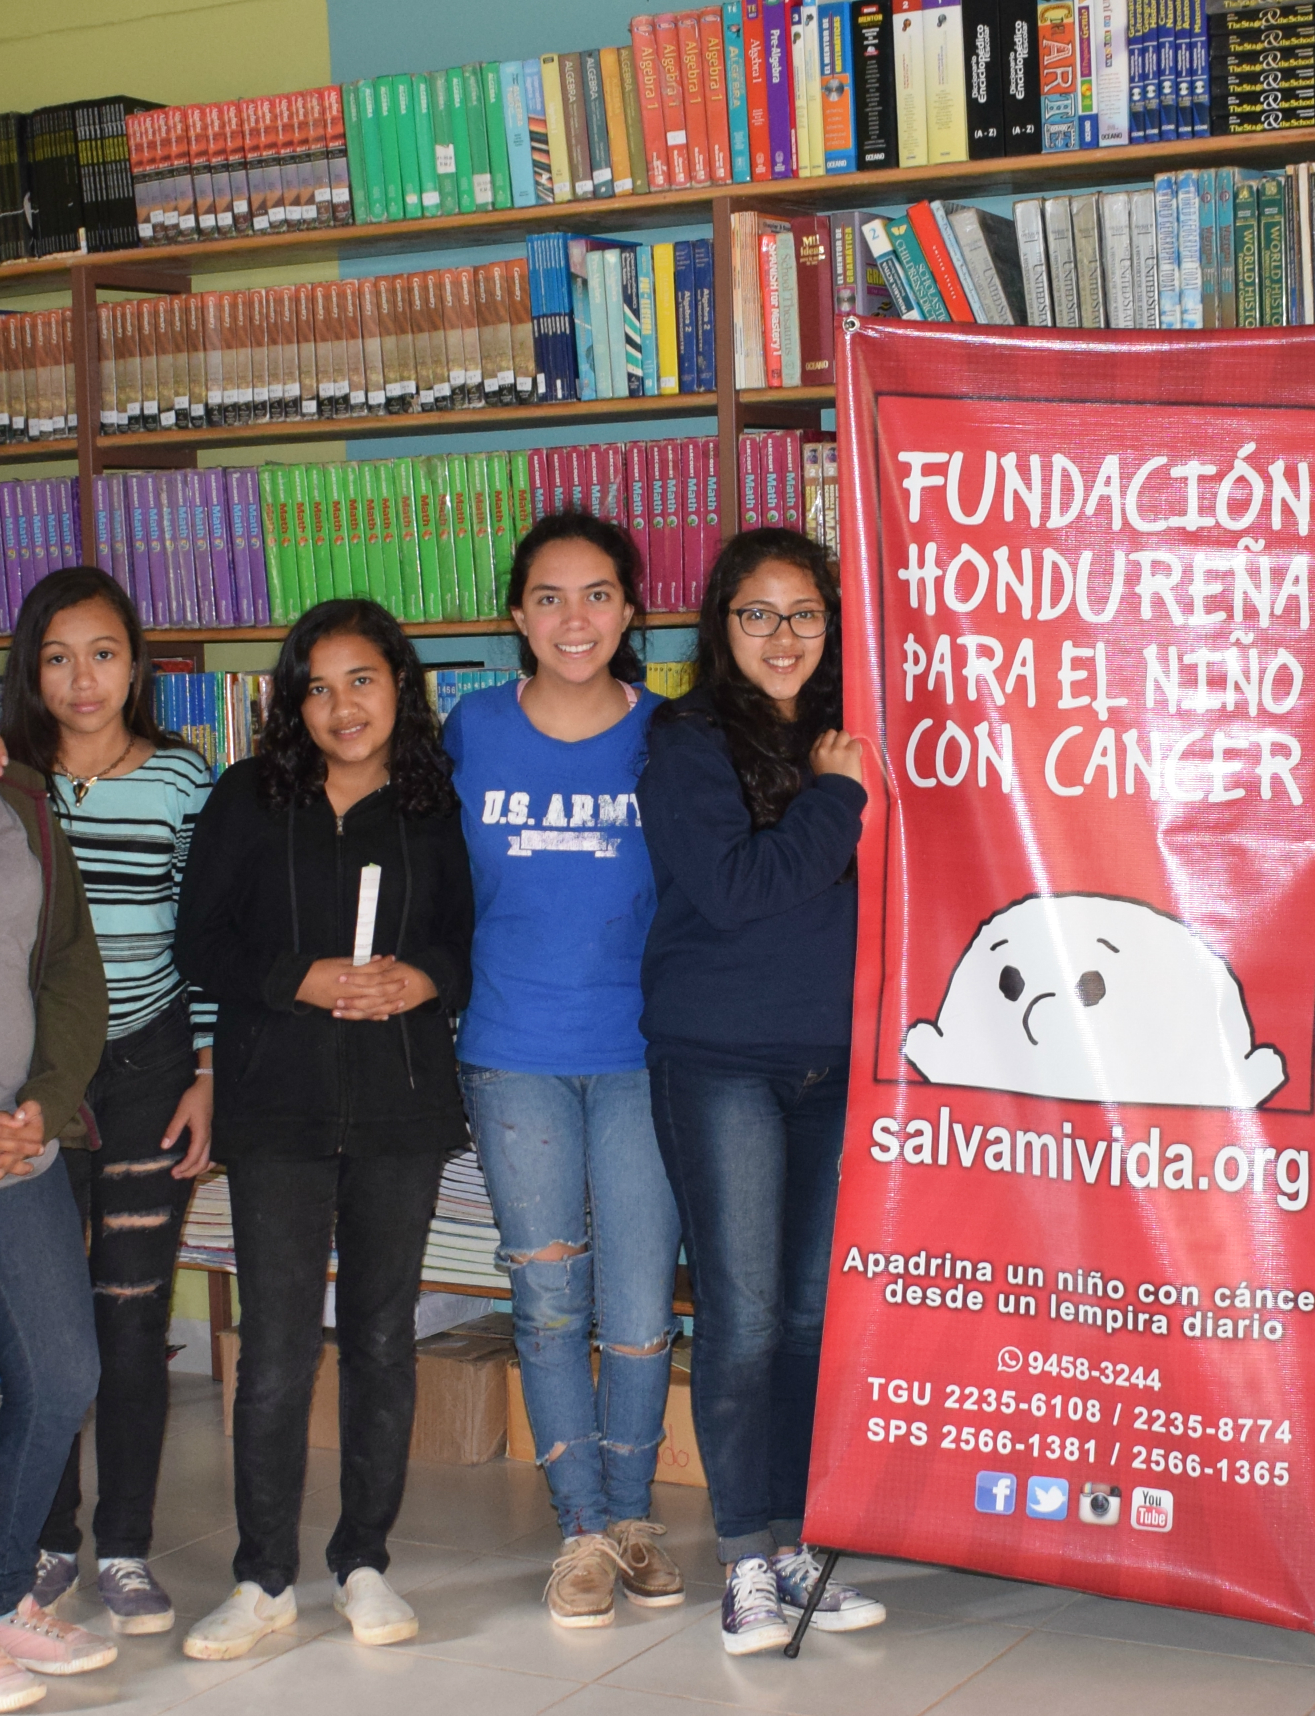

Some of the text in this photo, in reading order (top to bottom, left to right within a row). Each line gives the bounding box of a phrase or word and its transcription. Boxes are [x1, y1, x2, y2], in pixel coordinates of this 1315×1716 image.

[858, 14, 883, 23] MENTOR
[620, 49, 632, 93] ALGEBRA
[640, 47, 656, 99] Algebra
[662, 44, 677, 96] Algebra
[684, 41, 700, 93] Algebra
[706, 38, 722, 90] Algebra
[746, 38, 763, 77] Algebra
[769, 29, 782, 84] Pre-Algebra
[564, 60, 576, 104] ALGEBRA
[586, 56, 598, 101] ALGEBRA
[1101, 132, 1122, 141] OCEANO
[827, 160, 847, 169] OCEANO
[865, 153, 885, 161] OCEANO
[869, 228, 880, 240] 2
[769, 242, 779, 289] SPANISH
[1243, 229, 1255, 328] WORLD HISTO
[771, 308, 781, 349] Mastery
[806, 361, 828, 370] OCEANO
[707, 476, 717, 510] Math
[745, 474, 755, 508] Math
[766, 438, 777, 508] HARCOURT Math
[786, 472, 796, 506] Math
[898, 442, 1310, 536] FUNDACIÓN
[349, 499, 359, 530] Math
[366, 499, 376, 531] Math
[420, 495, 431, 527] Math
[494, 491, 504, 522] Math
[518, 490, 529, 521] Math
[687, 478, 698, 512] Math
[97, 511, 107, 542] Math
[212, 505, 222, 537] Math
[248, 504, 258, 535] Math
[296, 502, 306, 533] Math
[898, 537, 1310, 630] HONDUREÑA
[902, 631, 1303, 720] PARA EL NIÑO
[905, 718, 1303, 806] CON CANCER
[482, 790, 535, 825] U.S.
[870, 1107, 1310, 1210] salvamivida.org
[843, 1247, 993, 1283] Apadrina
[1007, 1264, 1043, 1287] un
[1058, 1270, 1125, 1300] niño
[1138, 1281, 1200, 1307] con
[885, 1279, 1283, 1341] desde un lempira diario
[1029, 1351, 1161, 1392] 9458-3244
[868, 1377, 1292, 1444] TGU 2235-6108 / 2235-8774
[657, 1424, 689, 1468] do
[867, 1417, 1289, 1486] SPS 2566-1381 / 2566-1365
[1137, 1509, 1167, 1527] Tube
[1142, 1490, 1162, 1508] You
